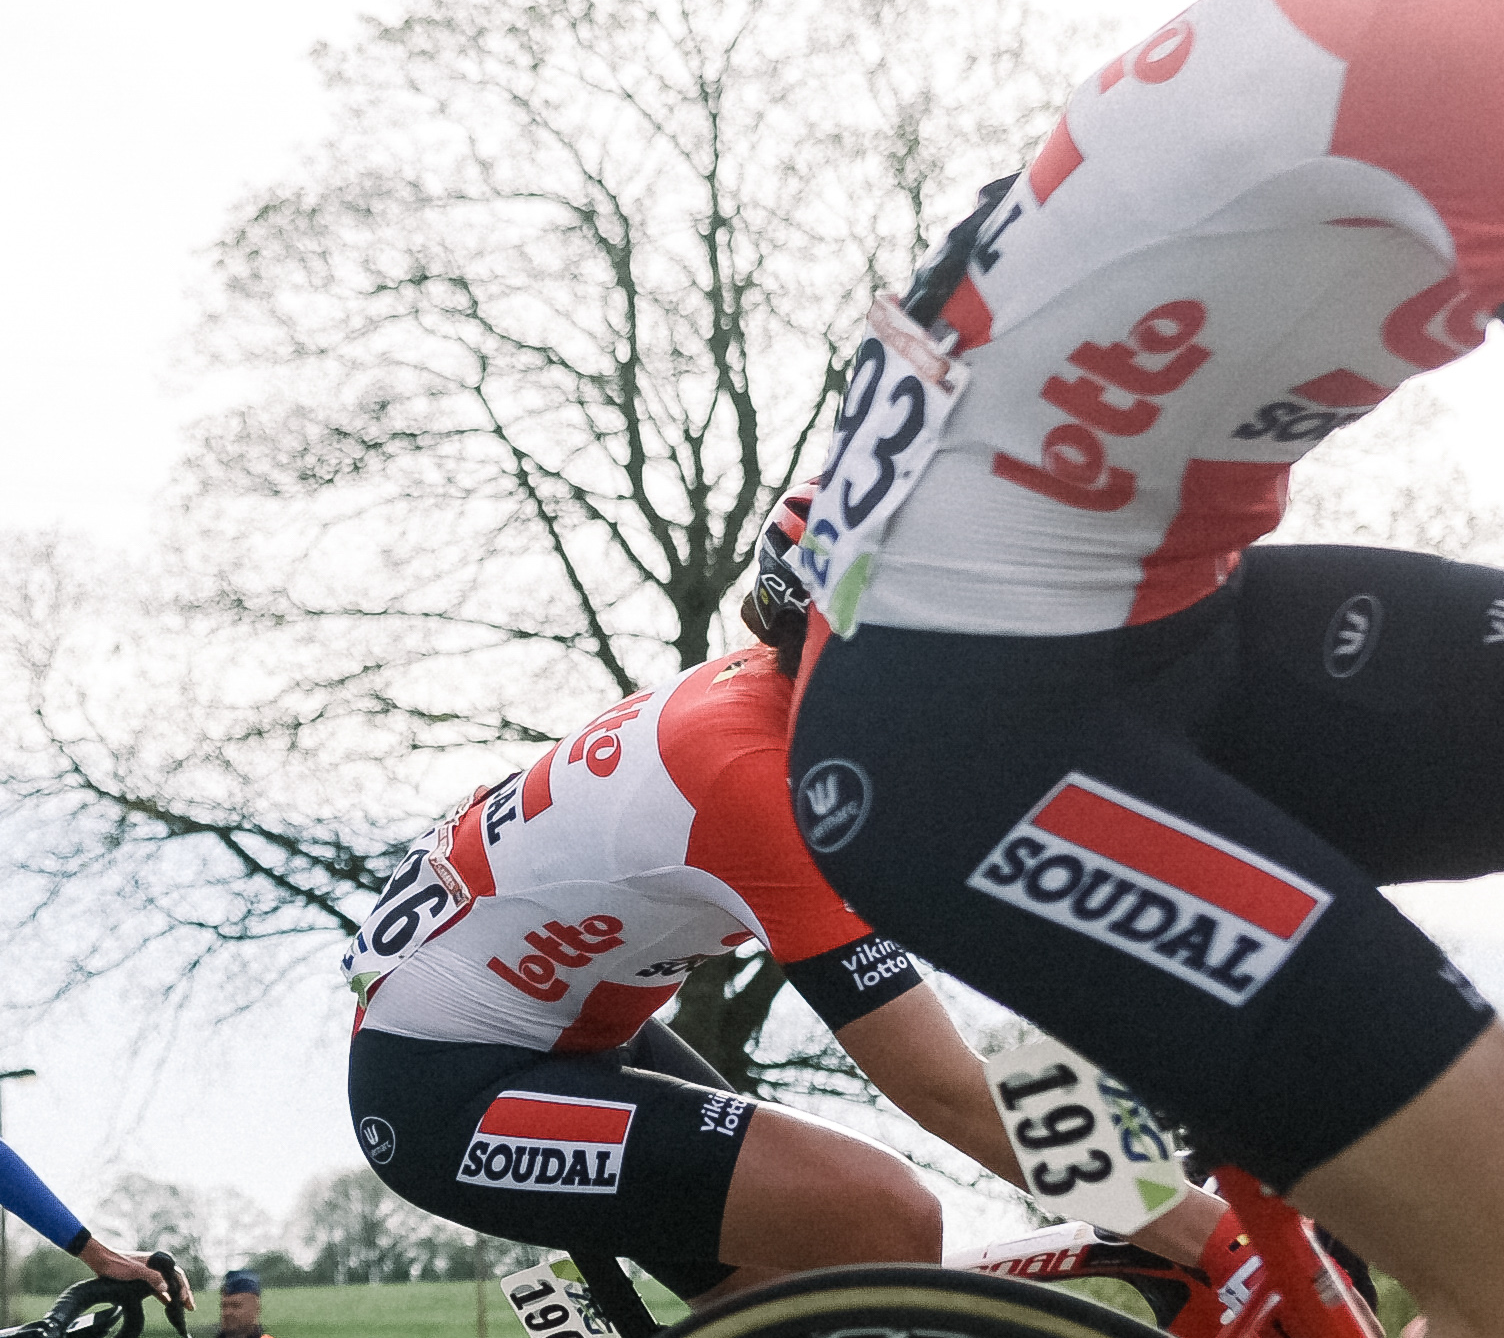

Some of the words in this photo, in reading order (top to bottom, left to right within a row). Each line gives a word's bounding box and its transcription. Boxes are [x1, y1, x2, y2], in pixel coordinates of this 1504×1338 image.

[993, 298, 1213, 513] lotto
[486, 913, 627, 1004] lotto
[988, 835, 1264, 992] SOUDAL
[853, 953, 909, 991] lotto
[460, 1139, 617, 1188] SOUDAL
[995, 1060, 1113, 1198] 193
